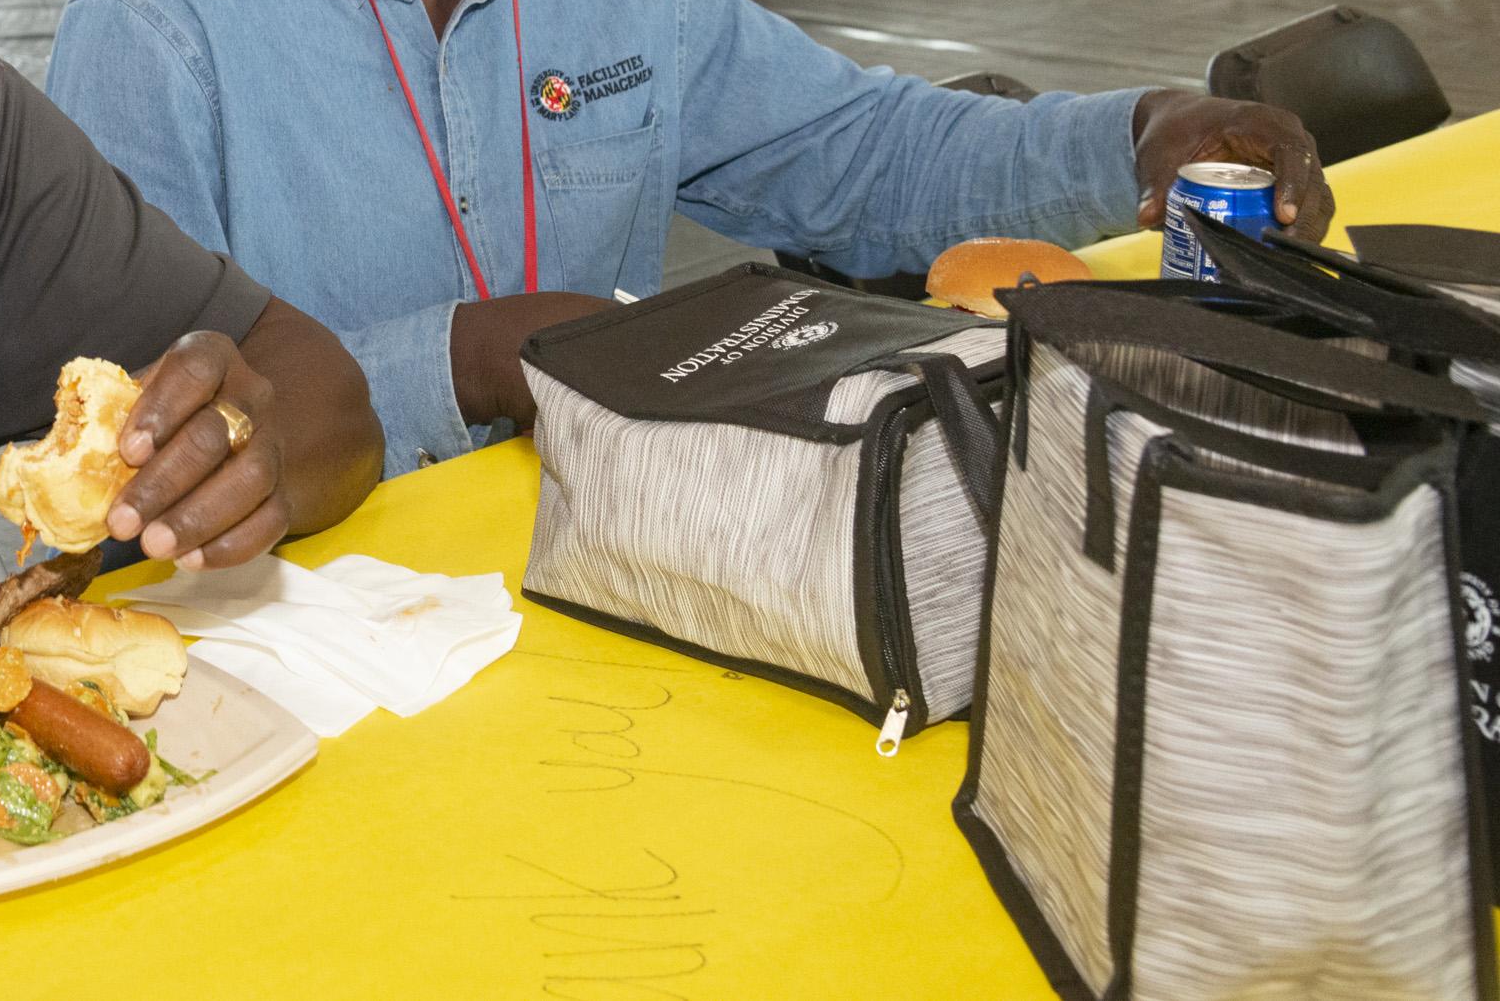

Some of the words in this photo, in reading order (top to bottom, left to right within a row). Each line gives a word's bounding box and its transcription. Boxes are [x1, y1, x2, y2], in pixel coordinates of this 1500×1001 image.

[577, 54, 644, 89] FACILITIES
[583, 65, 653, 104] MANAGEMEN
[536, 99, 582, 122] MARYLAND
[740, 305, 810, 351] DIVISION
